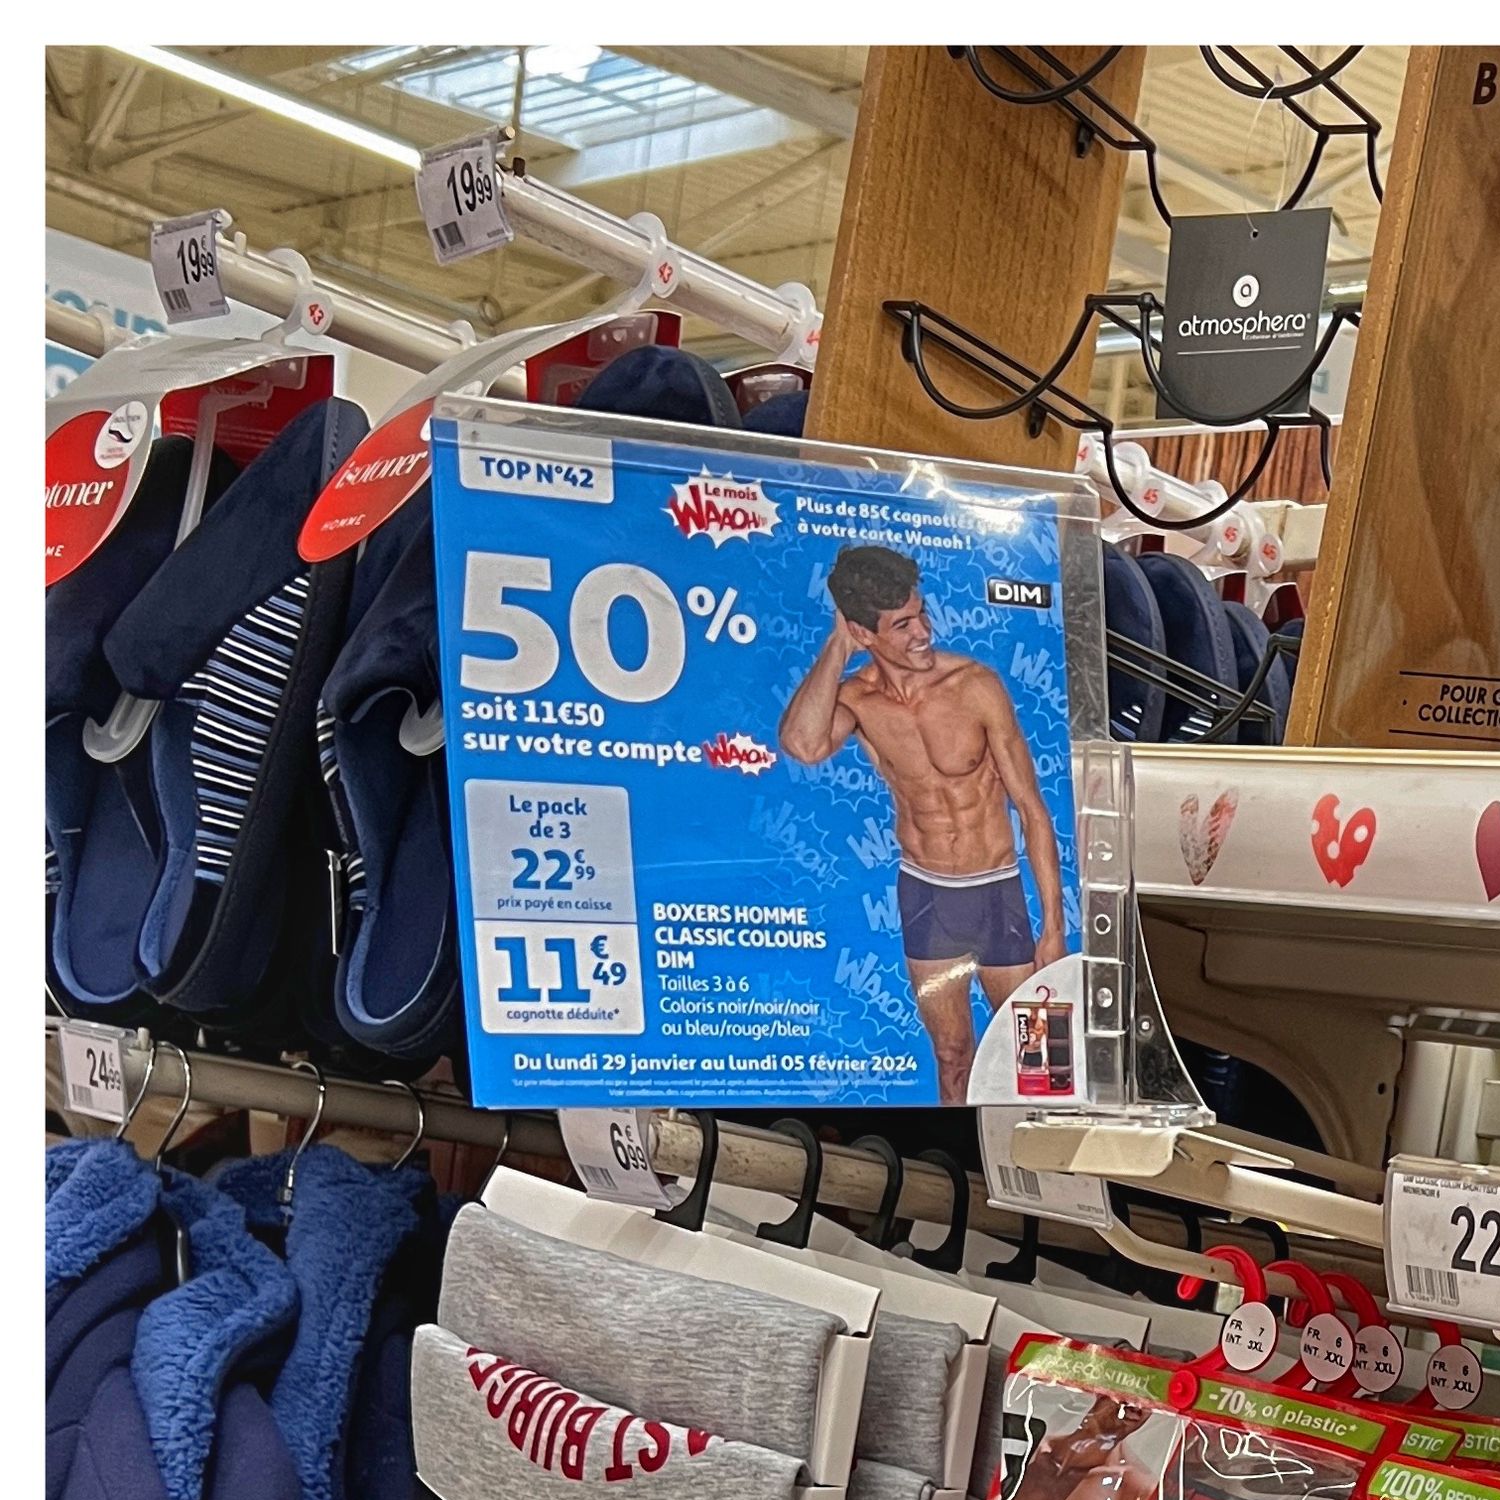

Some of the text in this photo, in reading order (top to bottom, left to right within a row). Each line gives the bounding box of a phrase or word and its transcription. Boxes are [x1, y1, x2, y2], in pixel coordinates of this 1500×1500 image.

[446, 160, 475, 215] 19
[176, 236, 202, 285] 19
[479, 456, 594, 488] TOP N°42
[704, 482, 758, 500] Le mois
[796, 496, 890, 521] Plus de 85€
[798, 519, 902, 544] à votre carte
[994, 583, 1042, 604] DIM
[1440, 684, 1487, 704] POUR
[461, 697, 605, 727] soit 11€50
[463, 732, 702, 766] sur votre compte
[510, 795, 588, 821] Le pack
[529, 821, 571, 839] de 3
[497, 896, 612, 911] prix payé en caisse
[653, 902, 808, 925] BOXERS HOMME
[654, 927, 826, 949] CLASSIC COLOURS
[656, 950, 694, 969] DIM
[592, 962, 627, 986] 49
[658, 974, 749, 992] Tailles 3 à 6
[506, 1008, 564, 1022] cagnotte
[659, 998, 819, 1018] Coloris noir/noir/noir
[662, 1020, 810, 1041] ou bleu/rouge/bleu
[85, 1047, 110, 1089] 24
[514, 1053, 918, 1075] Du lundi 29 janvier au lundi 05 février 2024
[609, 1121, 627, 1171] 6
[1248, 1339, 1264, 1353] 3XL
[1208, 1387, 1257, 1418] -70%
[1261, 1404, 1283, 1418] of
